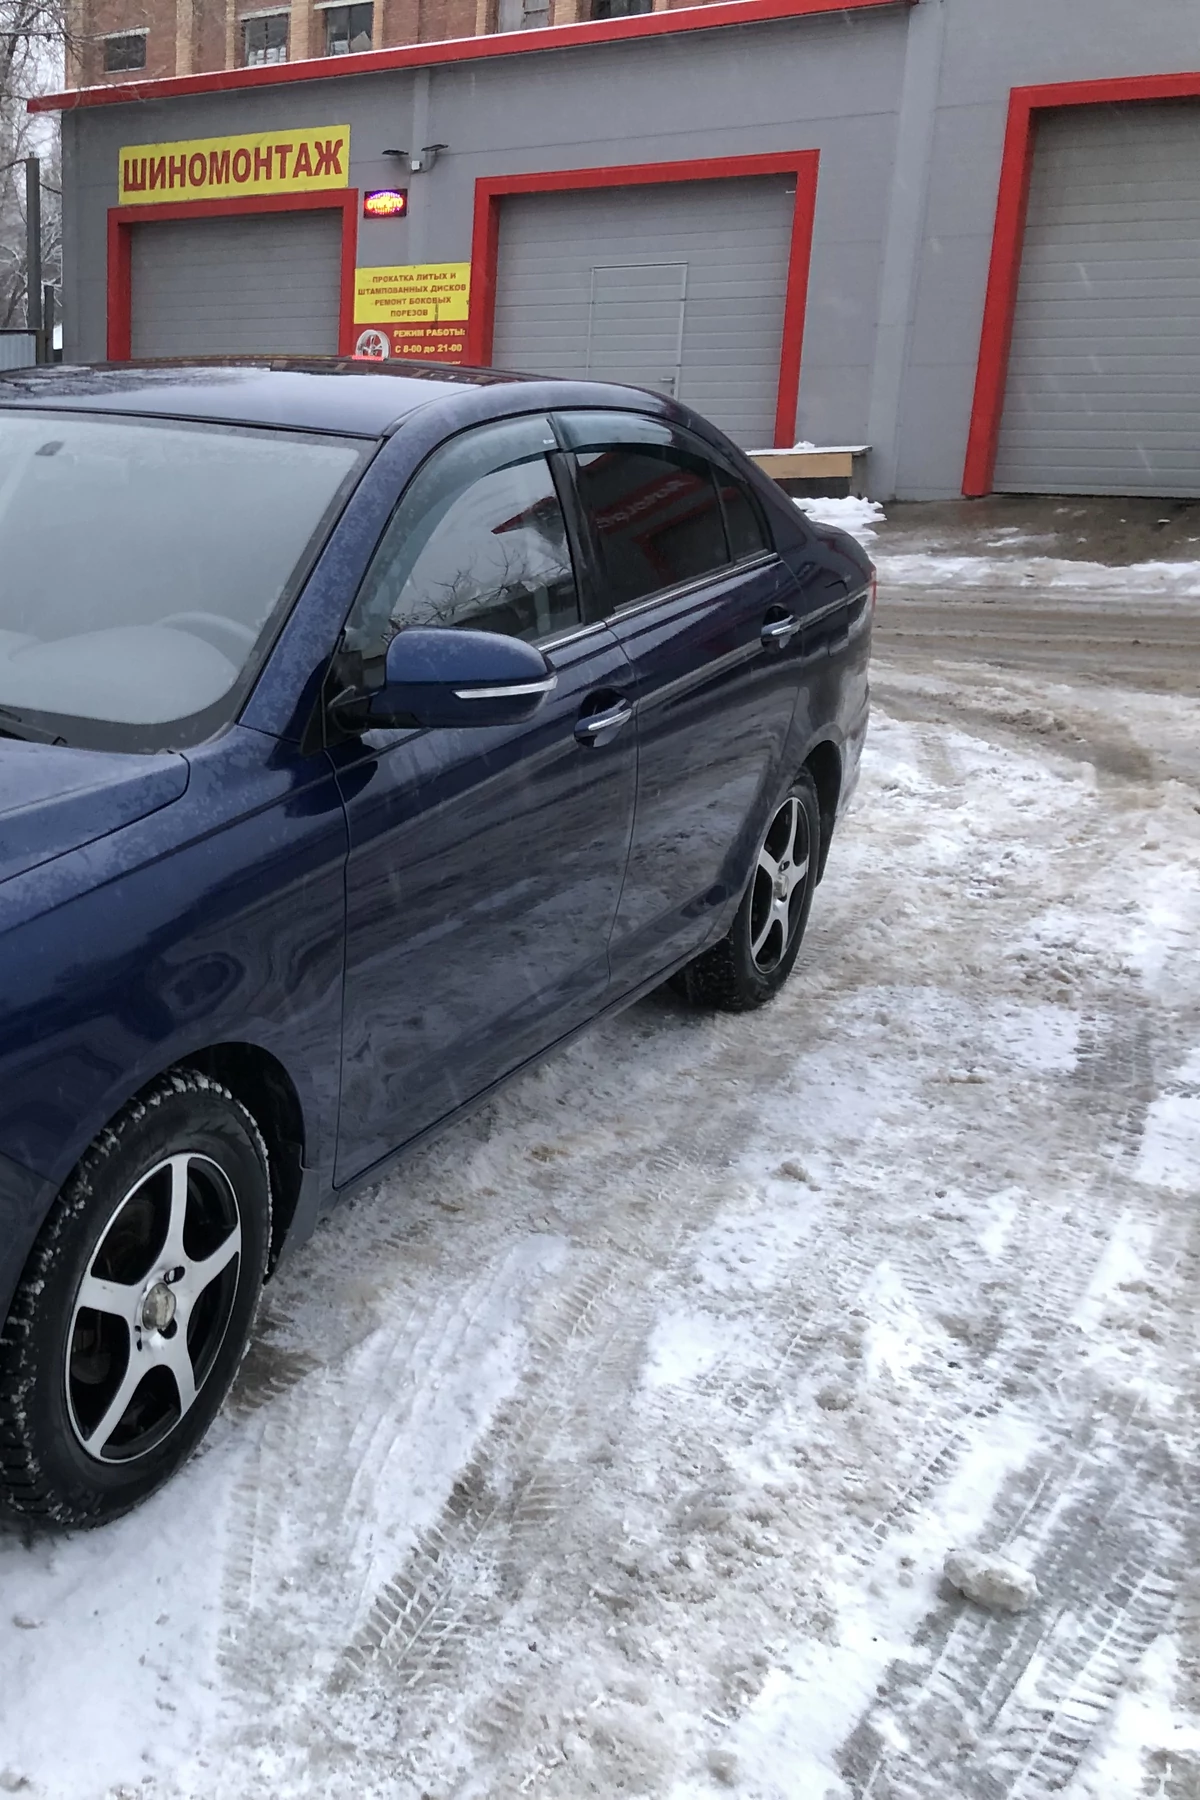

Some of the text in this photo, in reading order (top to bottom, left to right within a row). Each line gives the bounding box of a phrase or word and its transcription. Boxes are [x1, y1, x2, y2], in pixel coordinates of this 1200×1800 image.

[123, 138, 343, 192] ШИНОМОНТАЖ
[372, 272, 457, 283] ПРОКАТКА ЛИТЫХ И
[358, 284, 466, 296] ШТАМПОВАННЫХ ДИСКОВ
[374, 296, 452, 306] РЕМОНТ БОКОВЫХ
[390, 309, 429, 317] ПОРЕЗОВ
[393, 328, 466, 338] РЕЖИМ РАБОТЫ:
[403, 344, 422, 353] 8-00
[423, 345, 436, 354] до
[437, 343, 463, 353] 21-00
